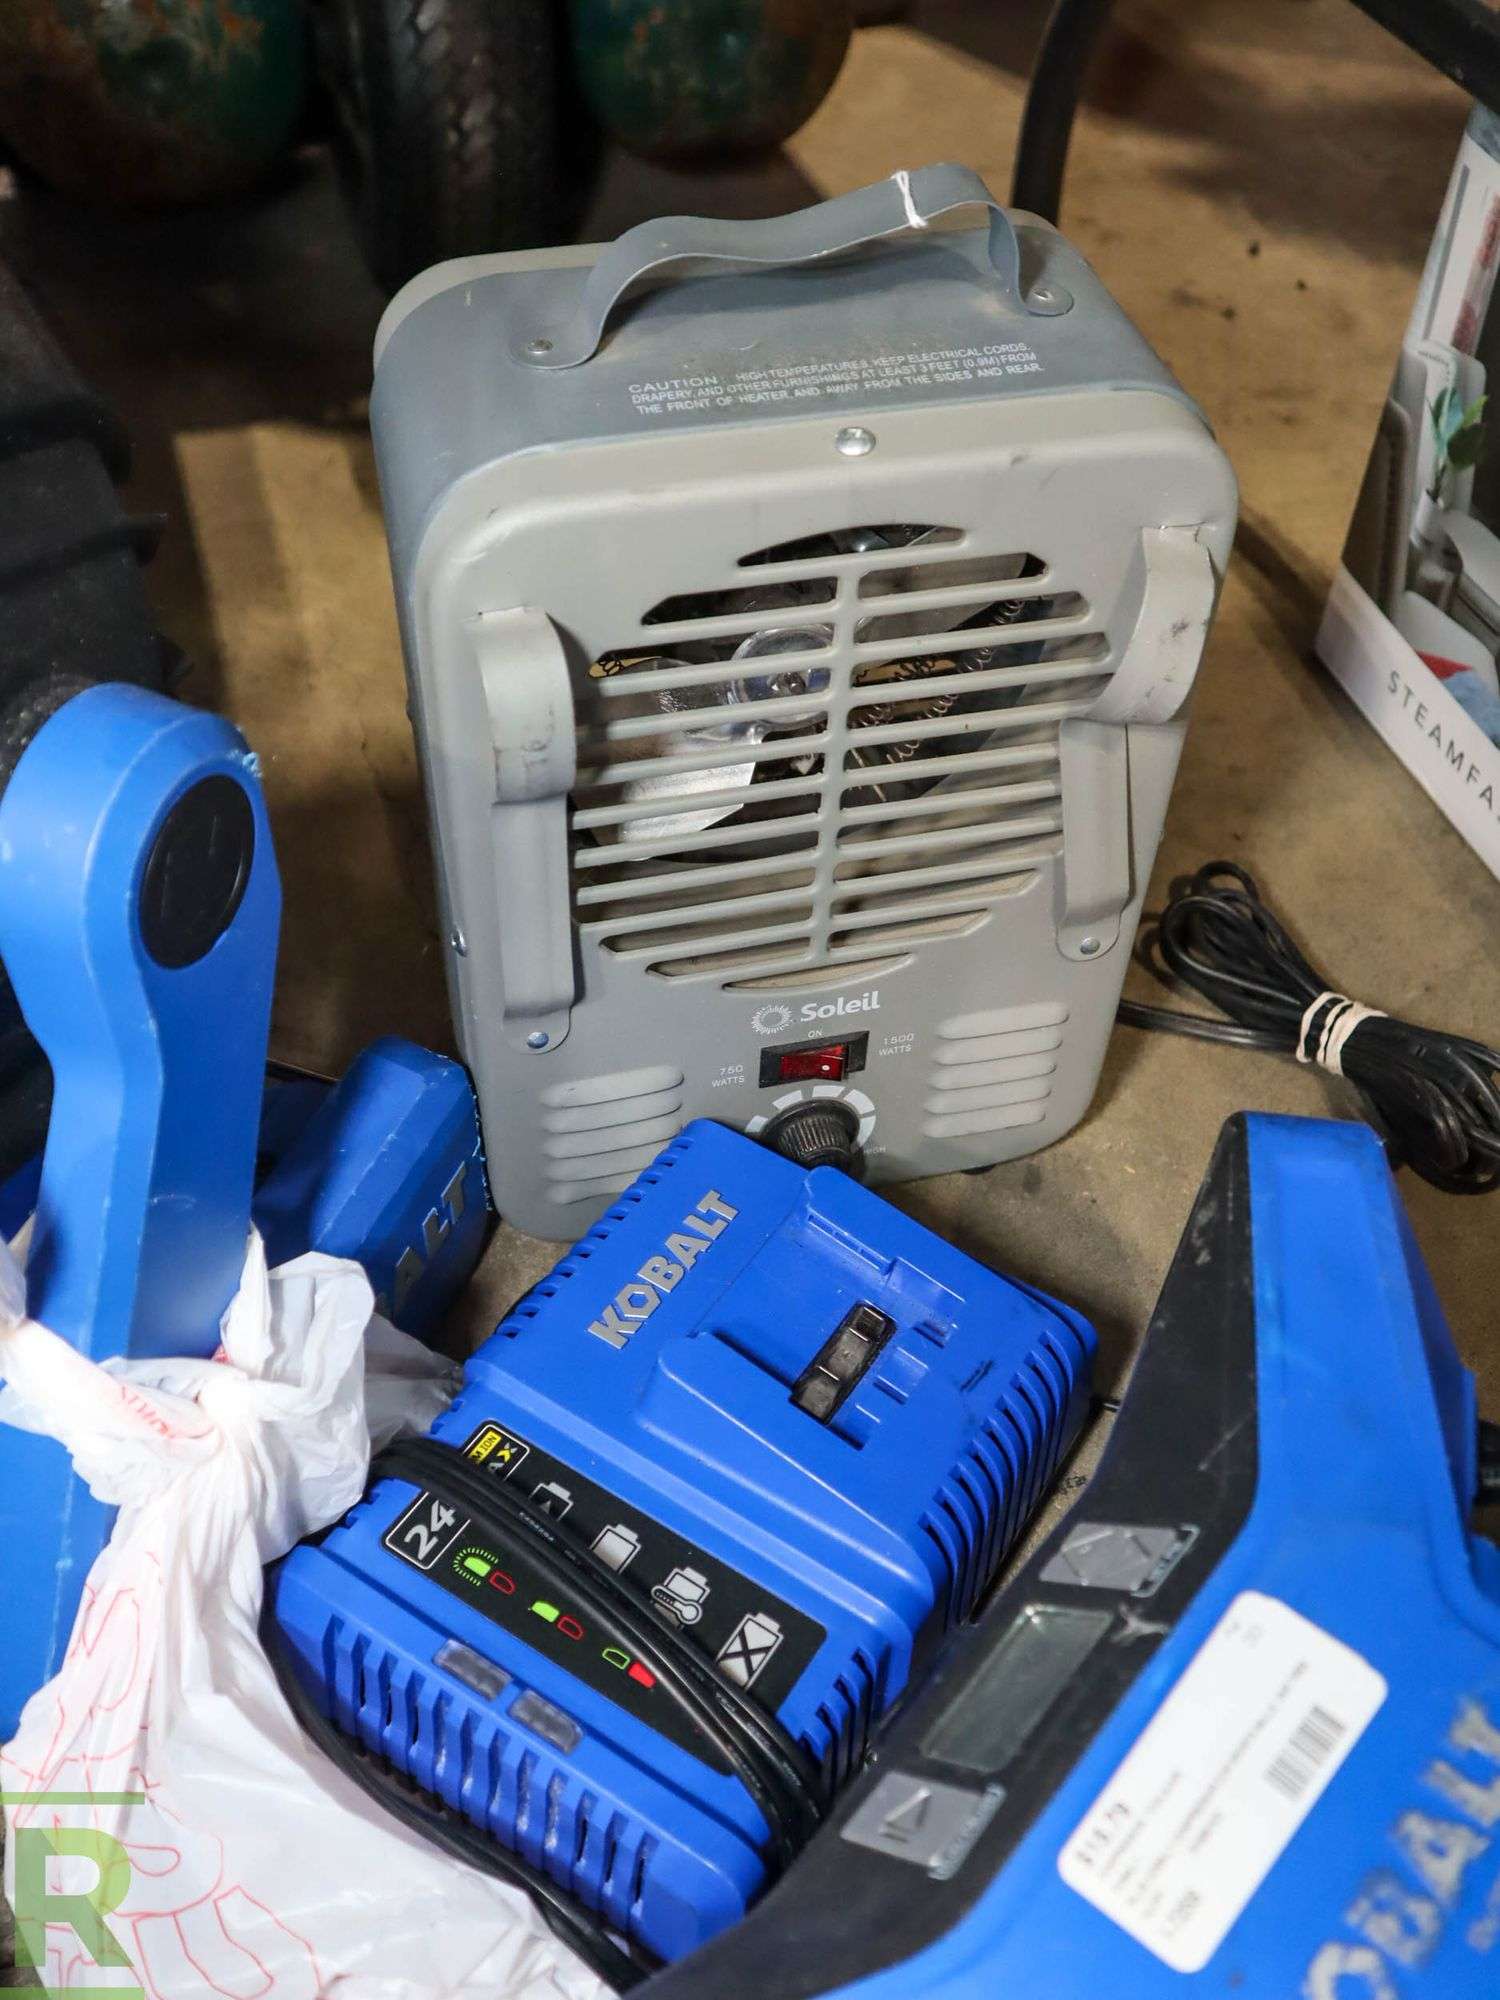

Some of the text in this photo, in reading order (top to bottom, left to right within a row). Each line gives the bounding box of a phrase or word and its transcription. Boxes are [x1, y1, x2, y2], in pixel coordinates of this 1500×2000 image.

[697, 385, 724, 398] AND
[727, 380, 771, 393] OTHER
[772, 369, 860, 389] FURNISHINGS
[862, 368, 876, 379] AT
[879, 364, 917, 377] LEAST
[919, 362, 929, 373] 3
[929, 359, 960, 372] FEET
[1001, 351, 1037, 364] FROM
[908, 347, 982, 363] ELECTRICAL
[636, 403, 663, 416] THE
[666, 398, 711, 412] FRONT
[716, 395, 734, 407] OF
[794, 386, 820, 398] AND
[826, 383, 858, 394] AWAY
[863, 378, 901, 391] FROM
[905, 374, 932, 385] THE
[934, 369, 973, 383] SIDES
[977, 366, 1003, 378] AND
[1387, 670, 1500, 823] STEAMFA
[800, 990, 880, 1022] Soleil
[807, 1028, 823, 1038] ON
[878, 1045, 912, 1056] WATTS
[711, 1075, 745, 1088] WATTS
[719, 1064, 744, 1077] 750
[382, 1161, 467, 1310] ALT
[587, 1189, 740, 1350] KOBALT
[404, 1500, 456, 1561] 24
